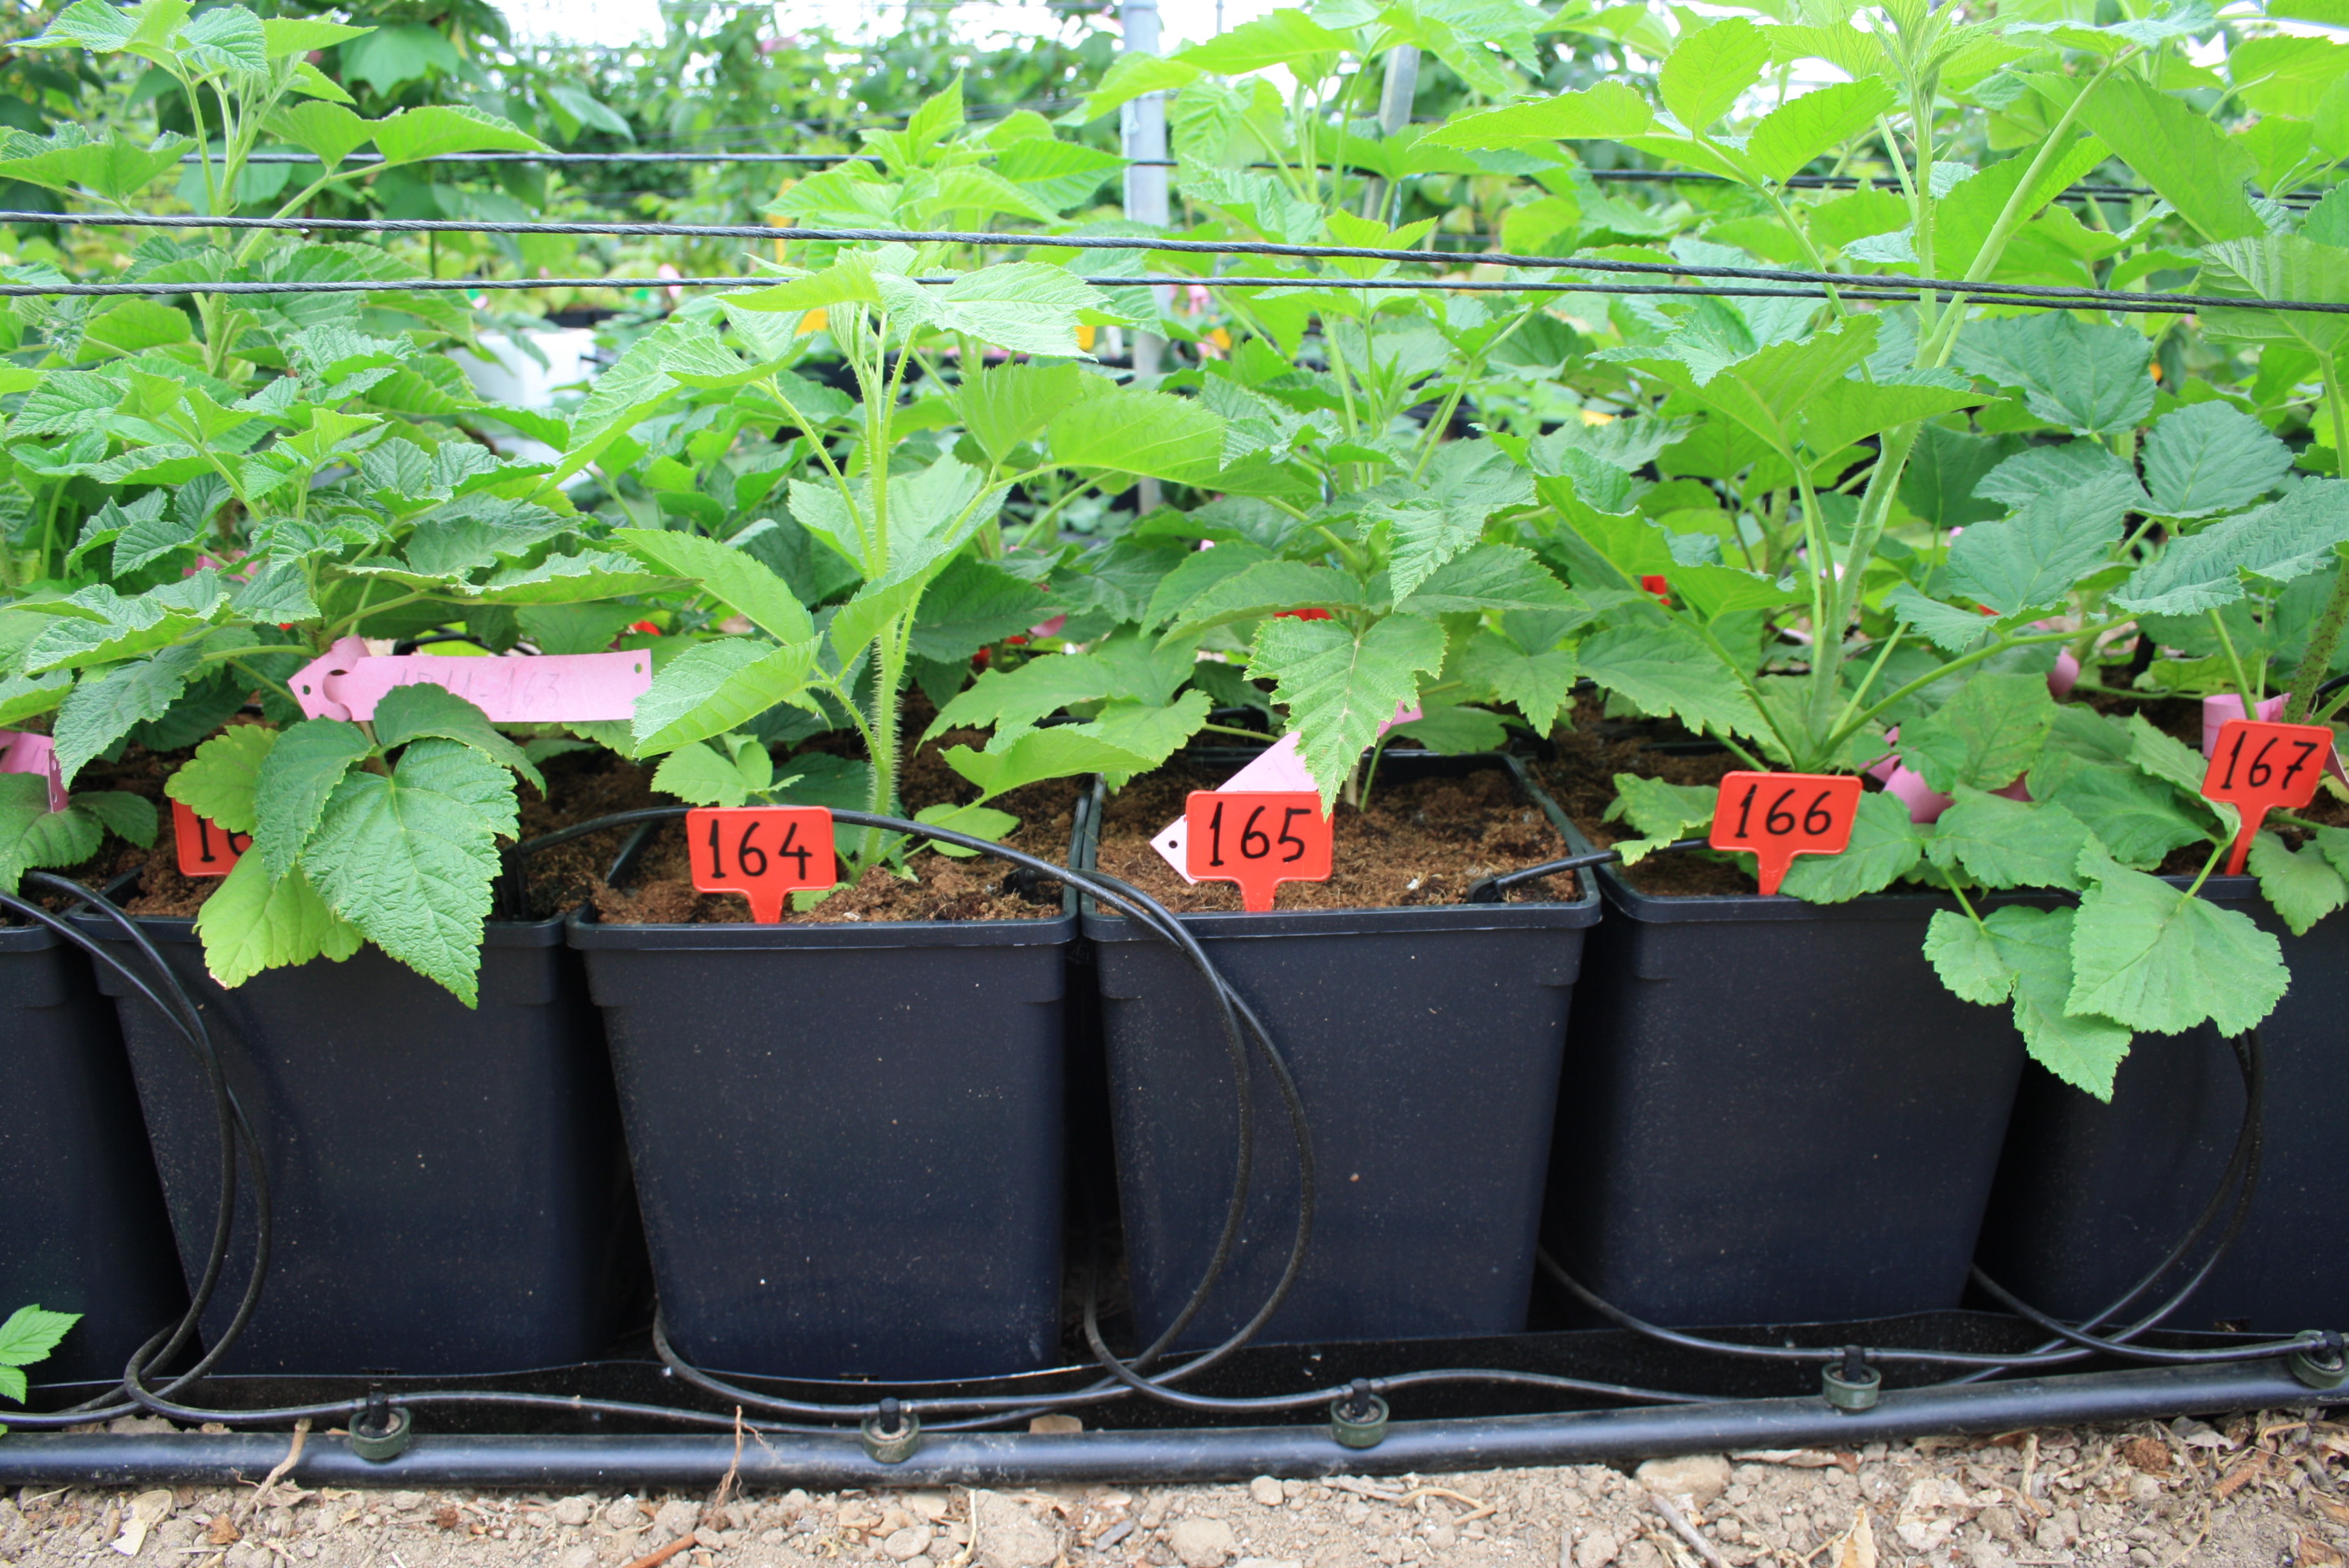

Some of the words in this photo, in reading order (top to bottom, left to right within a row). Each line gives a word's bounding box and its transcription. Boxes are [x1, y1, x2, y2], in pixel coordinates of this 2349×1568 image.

[2220, 731, 2319, 790] 167
[1210, 802, 1312, 867] 165
[1734, 783, 1833, 838] 166
[708, 818, 813, 881] 164
